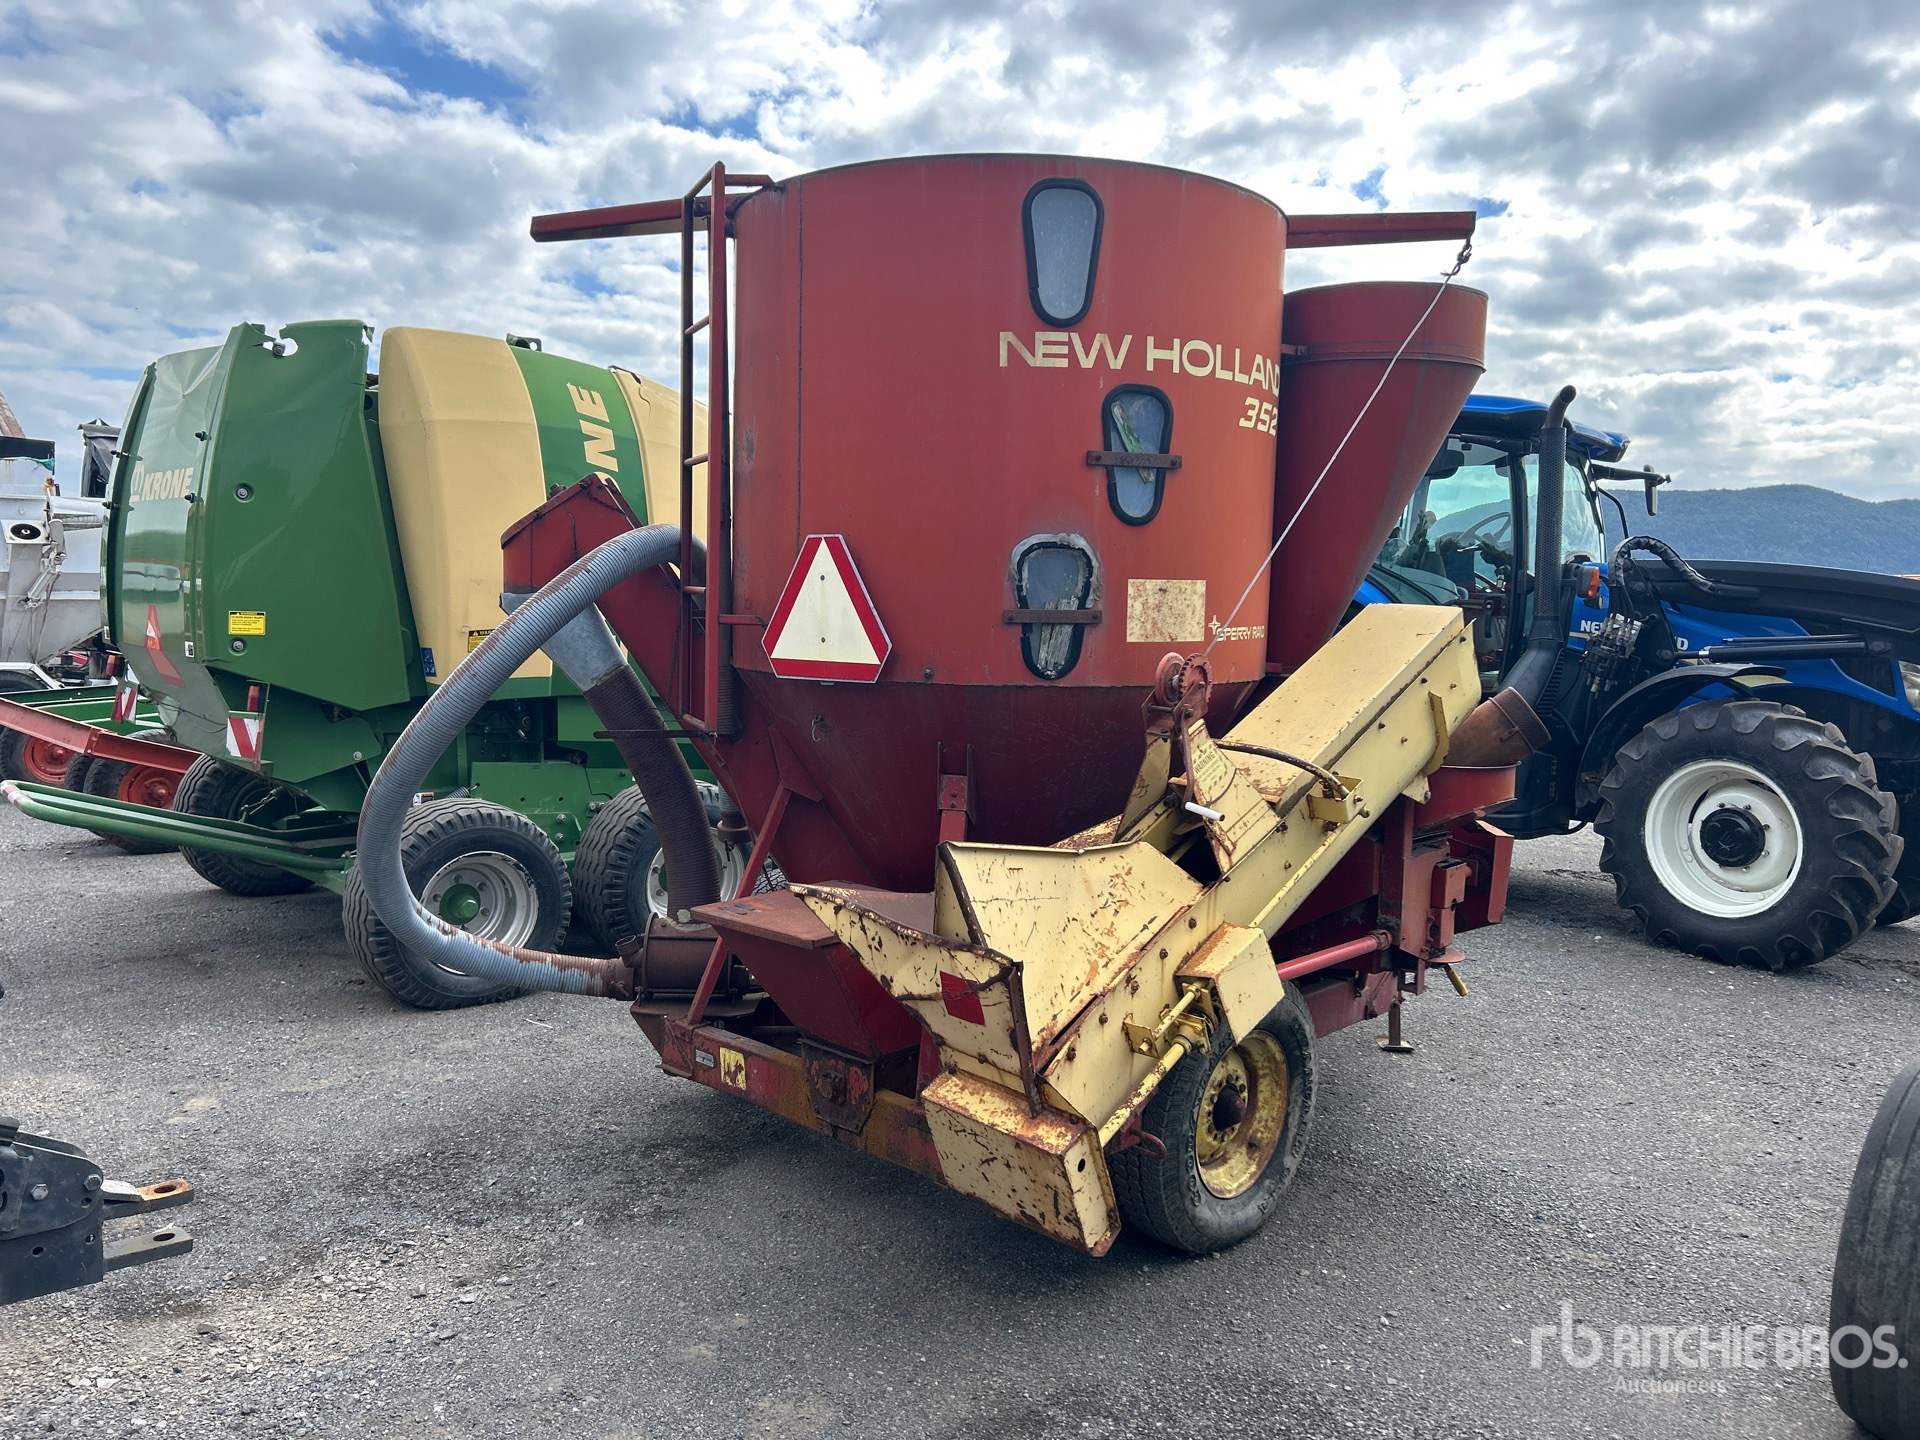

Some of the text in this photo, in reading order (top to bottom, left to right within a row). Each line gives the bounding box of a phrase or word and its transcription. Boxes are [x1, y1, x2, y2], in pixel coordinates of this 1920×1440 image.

[999, 331, 1132, 370] NEW
[141, 467, 195, 502] KRONE
[1216, 626, 1251, 641] SPERRY
[1193, 751, 1216, 775] WARNING
